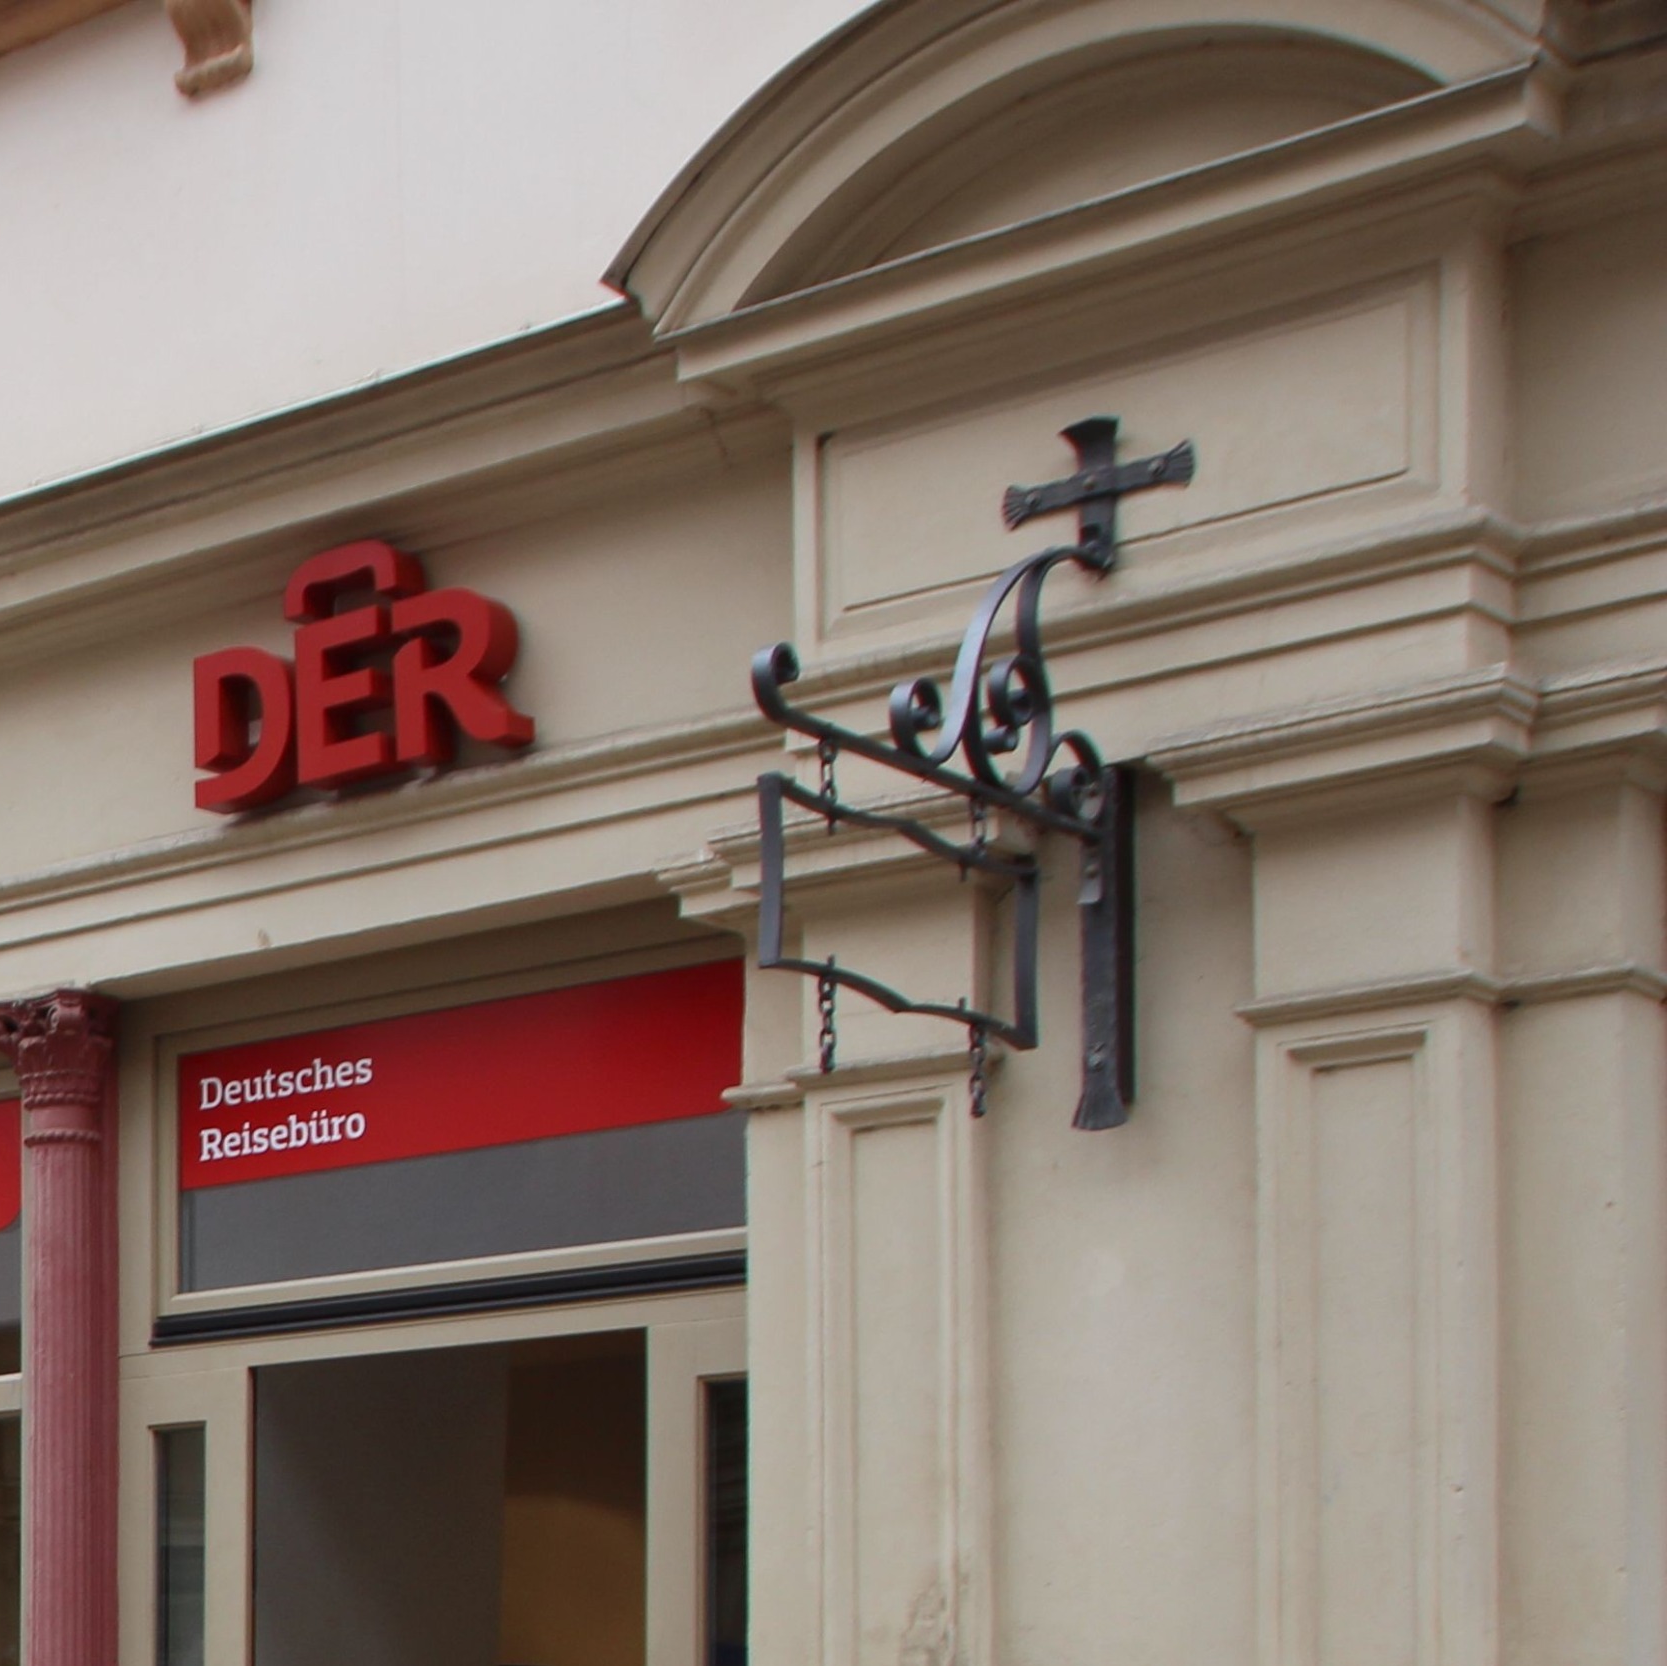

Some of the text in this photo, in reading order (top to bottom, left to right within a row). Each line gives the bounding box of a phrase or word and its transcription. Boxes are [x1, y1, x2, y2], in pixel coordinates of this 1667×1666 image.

[193, 538, 535, 815] DER
[200, 1058, 373, 1110] Deutsches
[199, 1109, 366, 1162] Reisebüro
